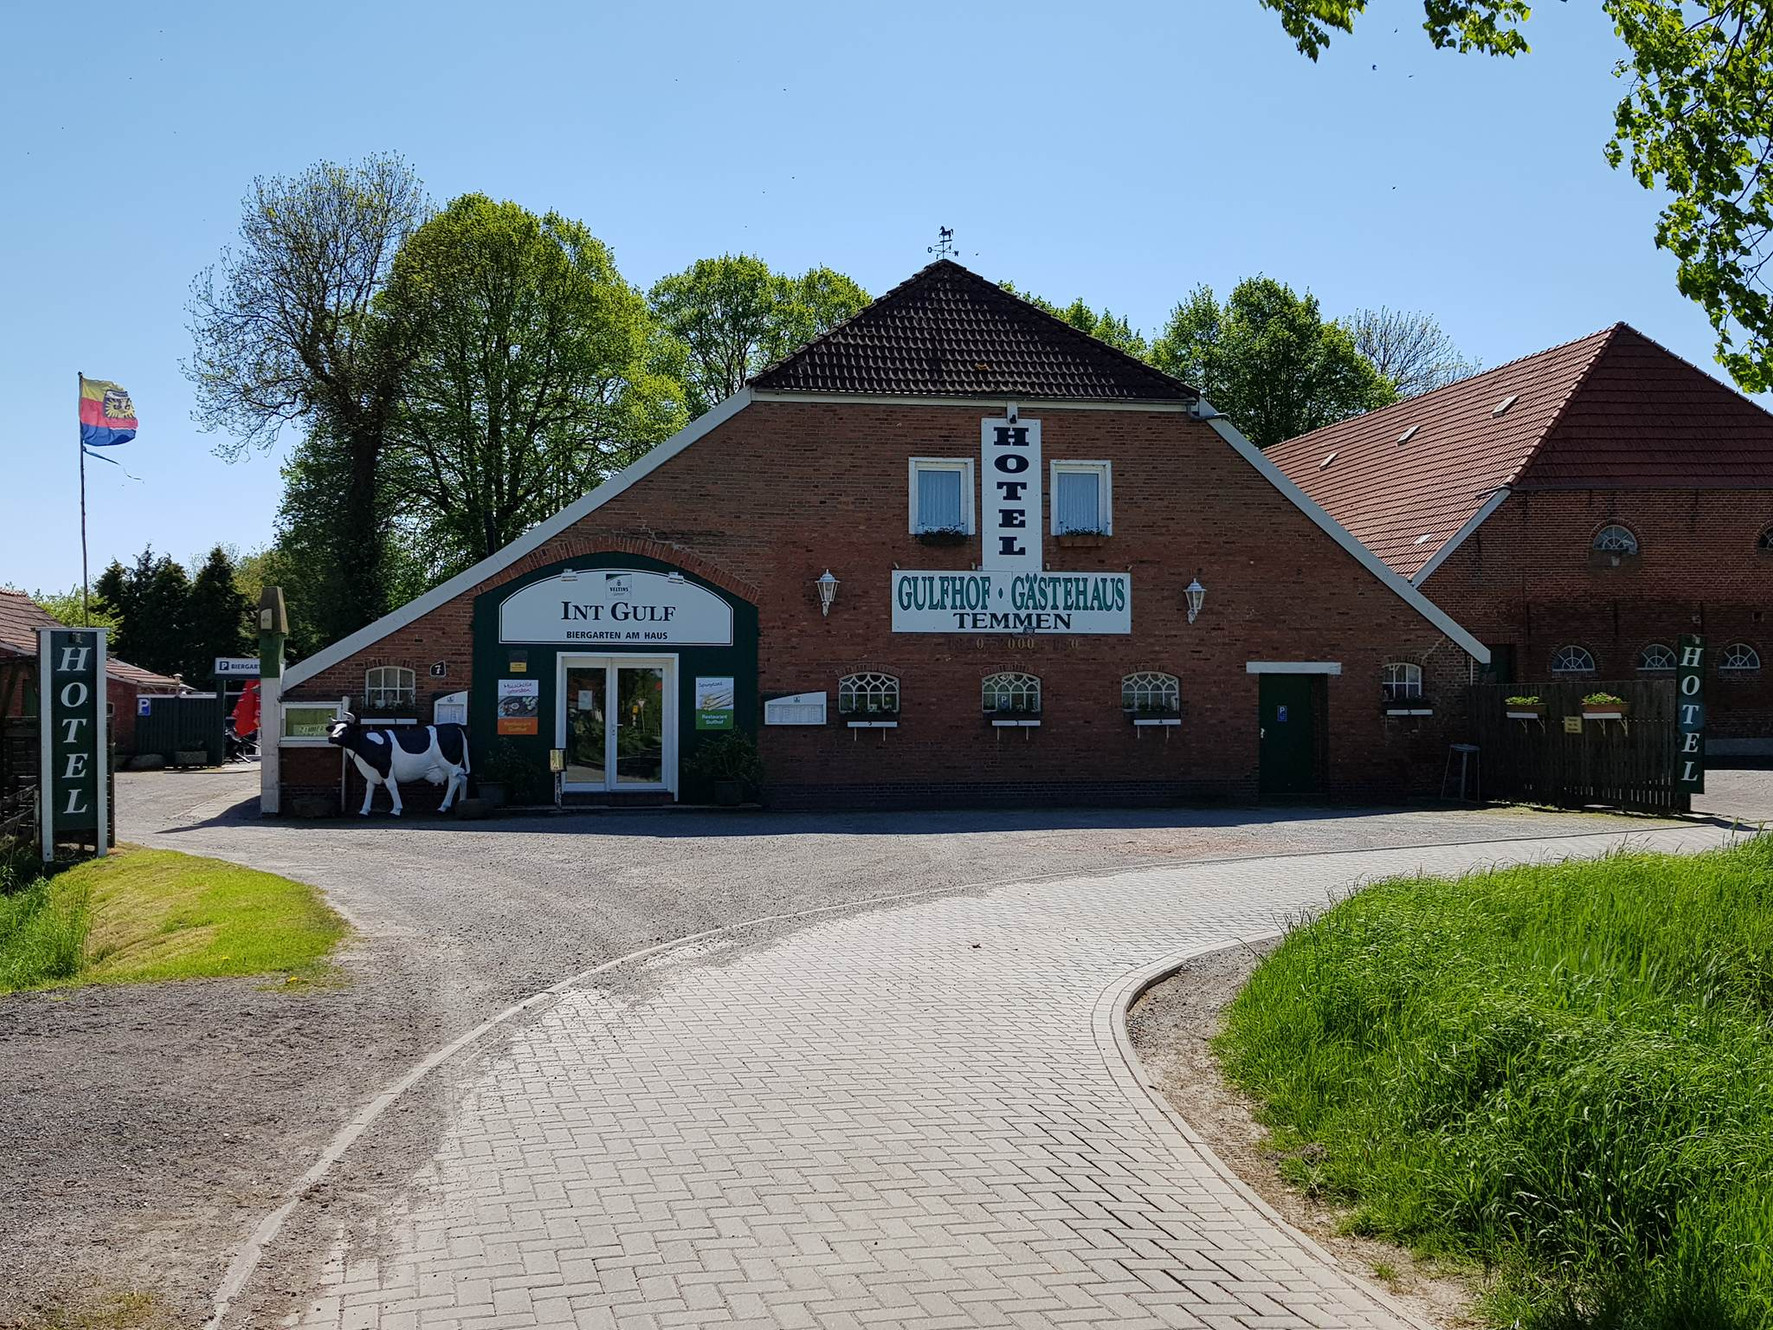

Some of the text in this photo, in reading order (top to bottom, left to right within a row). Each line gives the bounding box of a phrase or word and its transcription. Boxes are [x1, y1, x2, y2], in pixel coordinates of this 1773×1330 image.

[993, 426, 1029, 556] HOTEL
[898, 572, 1125, 611] GULFHOF GÄSTEHAUS
[952, 612, 1072, 630] TEMMEN
[566, 631, 668, 640] BIERGARTEN AM HAUS
[434, 665, 441, 674] 7
[138, 698, 149, 714] P
[1680, 646, 1704, 781] HOTEL
[57, 647, 91, 814] HOTEL
